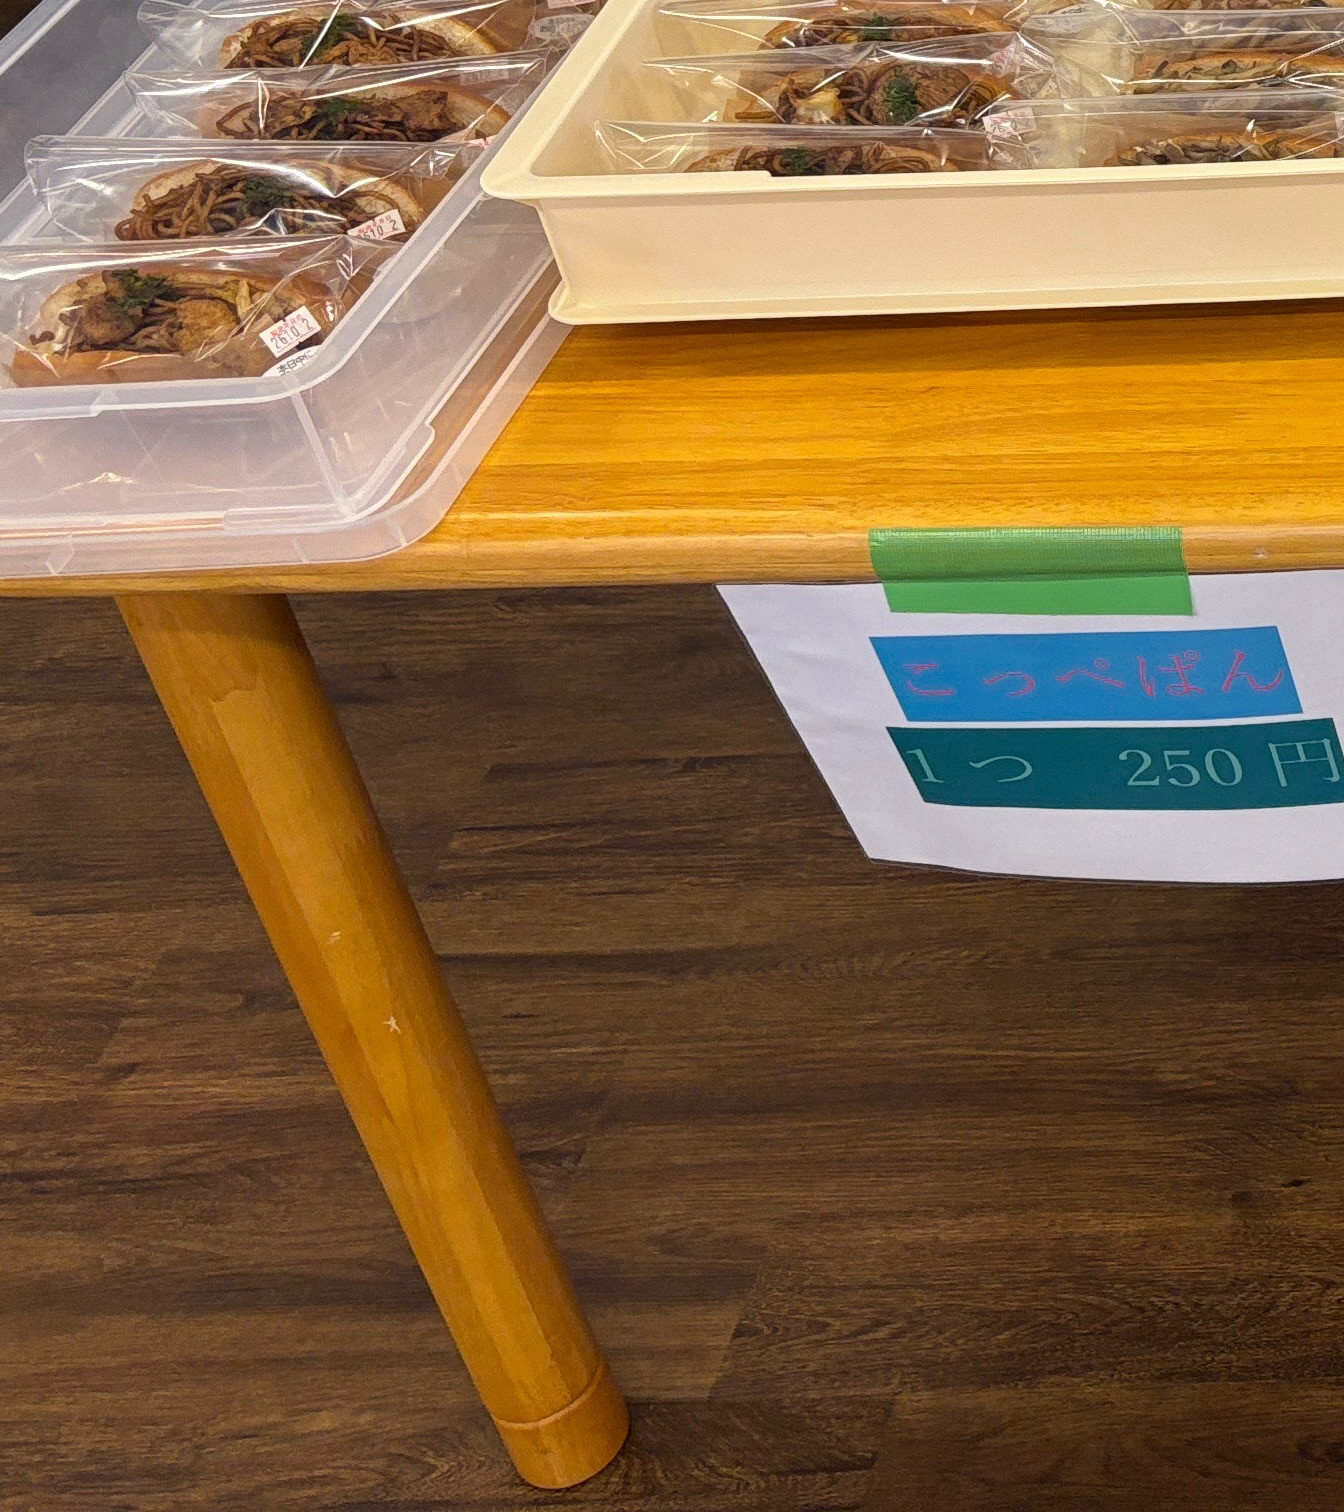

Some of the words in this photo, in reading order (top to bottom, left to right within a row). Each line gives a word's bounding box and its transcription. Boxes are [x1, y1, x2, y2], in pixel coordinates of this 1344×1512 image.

[902, 649, 1284, 699] こっぺぱん
[906, 746, 1034, 785] 1つ
[1117, 736, 1342, 788] 250円
